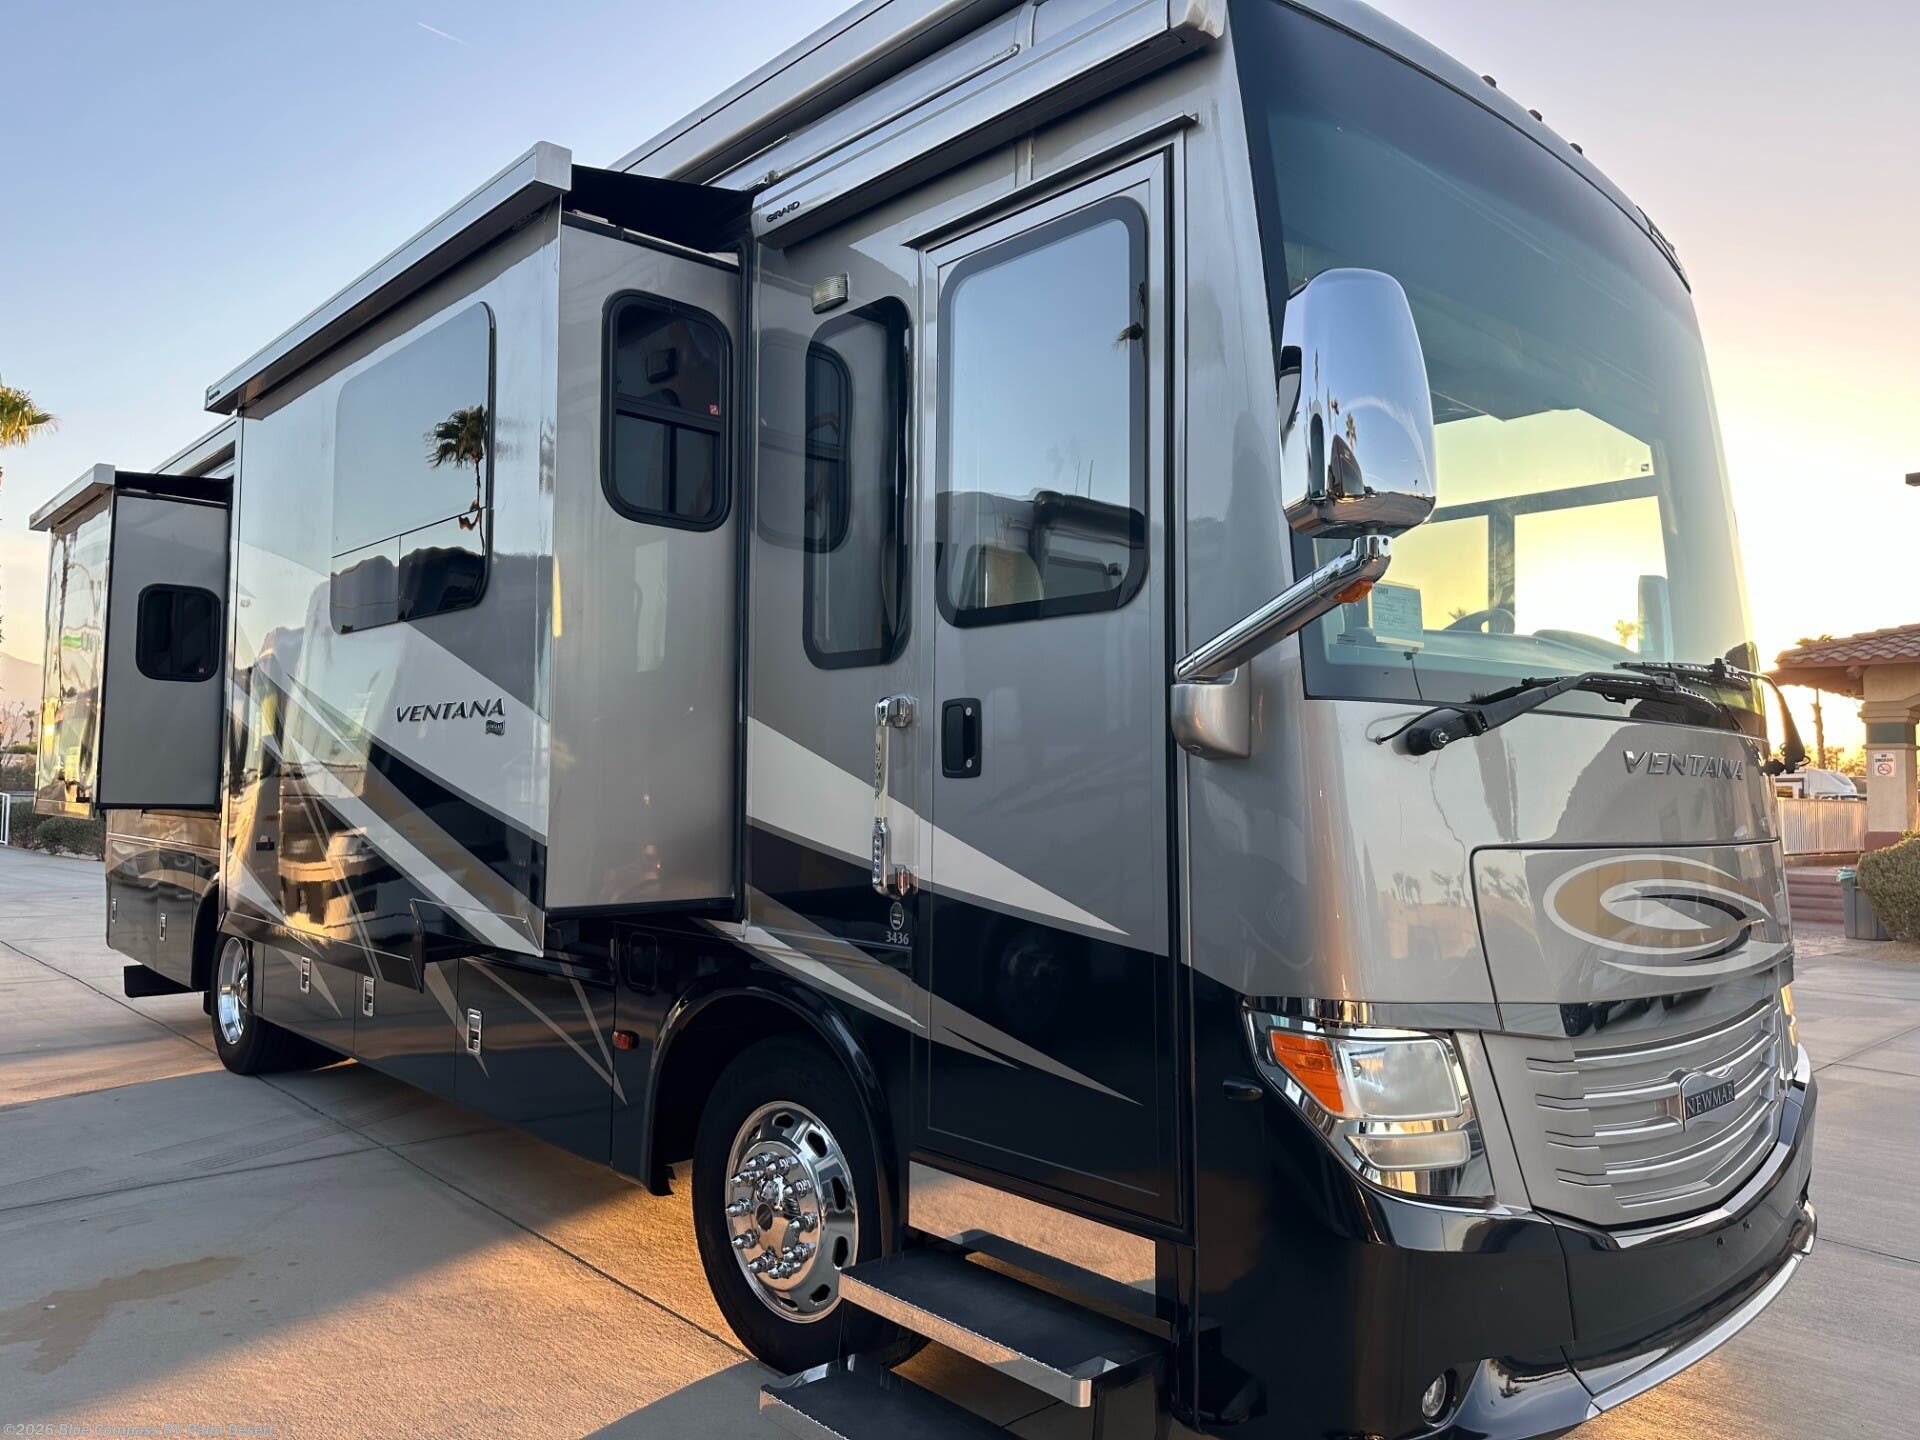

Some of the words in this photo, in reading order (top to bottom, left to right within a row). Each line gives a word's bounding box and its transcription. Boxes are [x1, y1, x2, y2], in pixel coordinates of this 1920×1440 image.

[396, 698, 505, 722] VENTANA
[1623, 750, 1744, 780] VENTANA
[885, 930, 910, 945] 3436
[1686, 1082, 1736, 1118] NEWMAR
